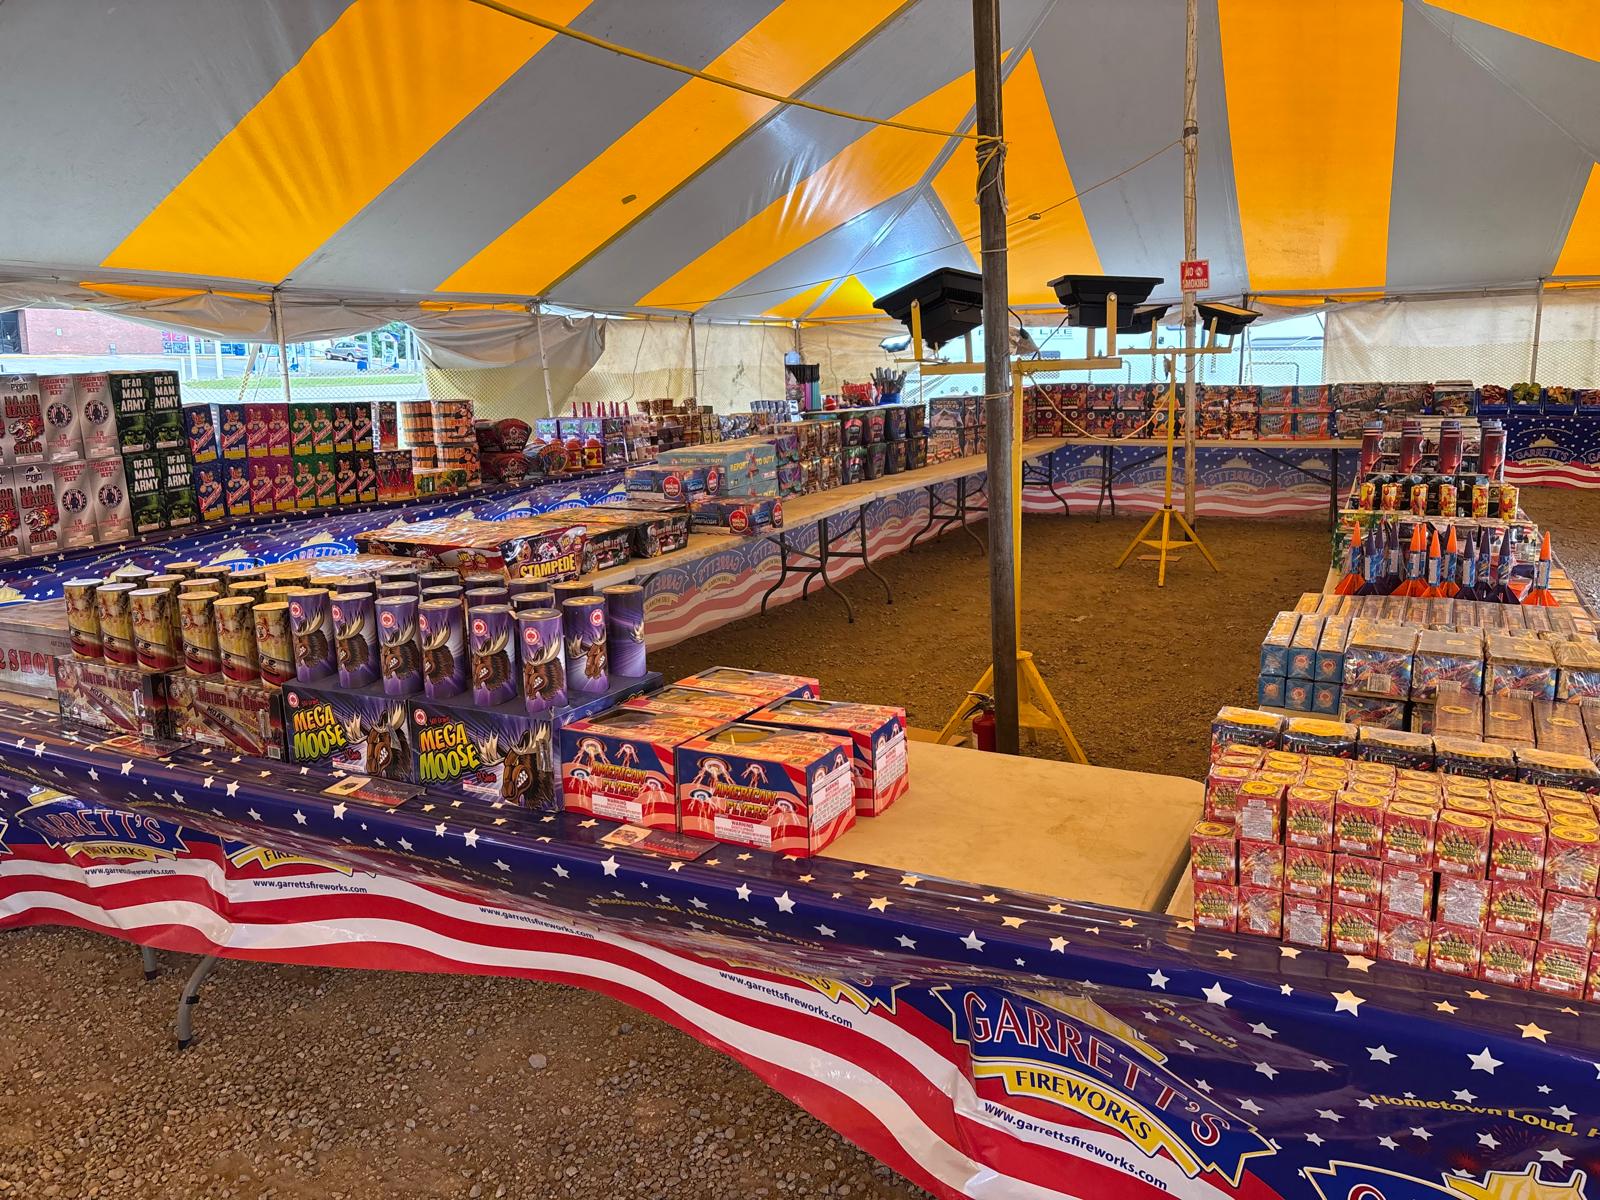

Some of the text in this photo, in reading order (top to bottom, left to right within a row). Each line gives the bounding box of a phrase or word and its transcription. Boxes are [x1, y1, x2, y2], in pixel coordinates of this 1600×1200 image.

[1186, 267, 1194, 277] NO
[1182, 278, 1208, 288] SMOKING
[122, 388, 143, 399] MAN
[154, 386, 175, 396] MAN
[4, 394, 39, 405] MAJOR
[121, 399, 147, 412] ARMY
[154, 396, 178, 409] ARMY
[5, 404, 41, 418] LEAGUE
[13, 441, 43, 455] SHELLS
[1516, 447, 1569, 461] GARRETT'S
[134, 468, 155, 479] MAN
[168, 464, 188, 474] MAN
[134, 478, 159, 493] ARMY
[168, 474, 191, 487] ARMY
[20, 484, 53, 496] MAJOR
[20, 495, 56, 509] LEAGUE
[29, 530, 57, 544] SHELLS
[519, 552, 576, 579] STAMPEDE
[8, 648, 56, 677] SHOT
[206, 706, 226, 722] MOAB
[293, 704, 335, 732] MEGA
[294, 724, 346, 759] MOOSE
[420, 722, 468, 752] MEGA
[420, 744, 480, 780] MOOSE
[591, 761, 648, 784] AMERICAN
[601, 779, 640, 798] FLYERS
[714, 782, 777, 806] AMERICAN
[725, 800, 769, 820] FLYERS
[253, 880, 367, 893] www.garrettsfireworks.com
[479, 906, 595, 939] www.garrettsfireworks.com
[687, 908, 771, 935] Hometown
[719, 971, 852, 1028] www.garrettsfireworks.com
[1178, 1015, 1239, 1049] Proud
[963, 991, 1230, 1147] GARRETT'S
[1015, 1070, 1152, 1140] FIREWORKS
[1370, 1093, 1579, 1137] Hometown Loud,
[984, 1102, 1168, 1190] www.garrettsfireworks.com
